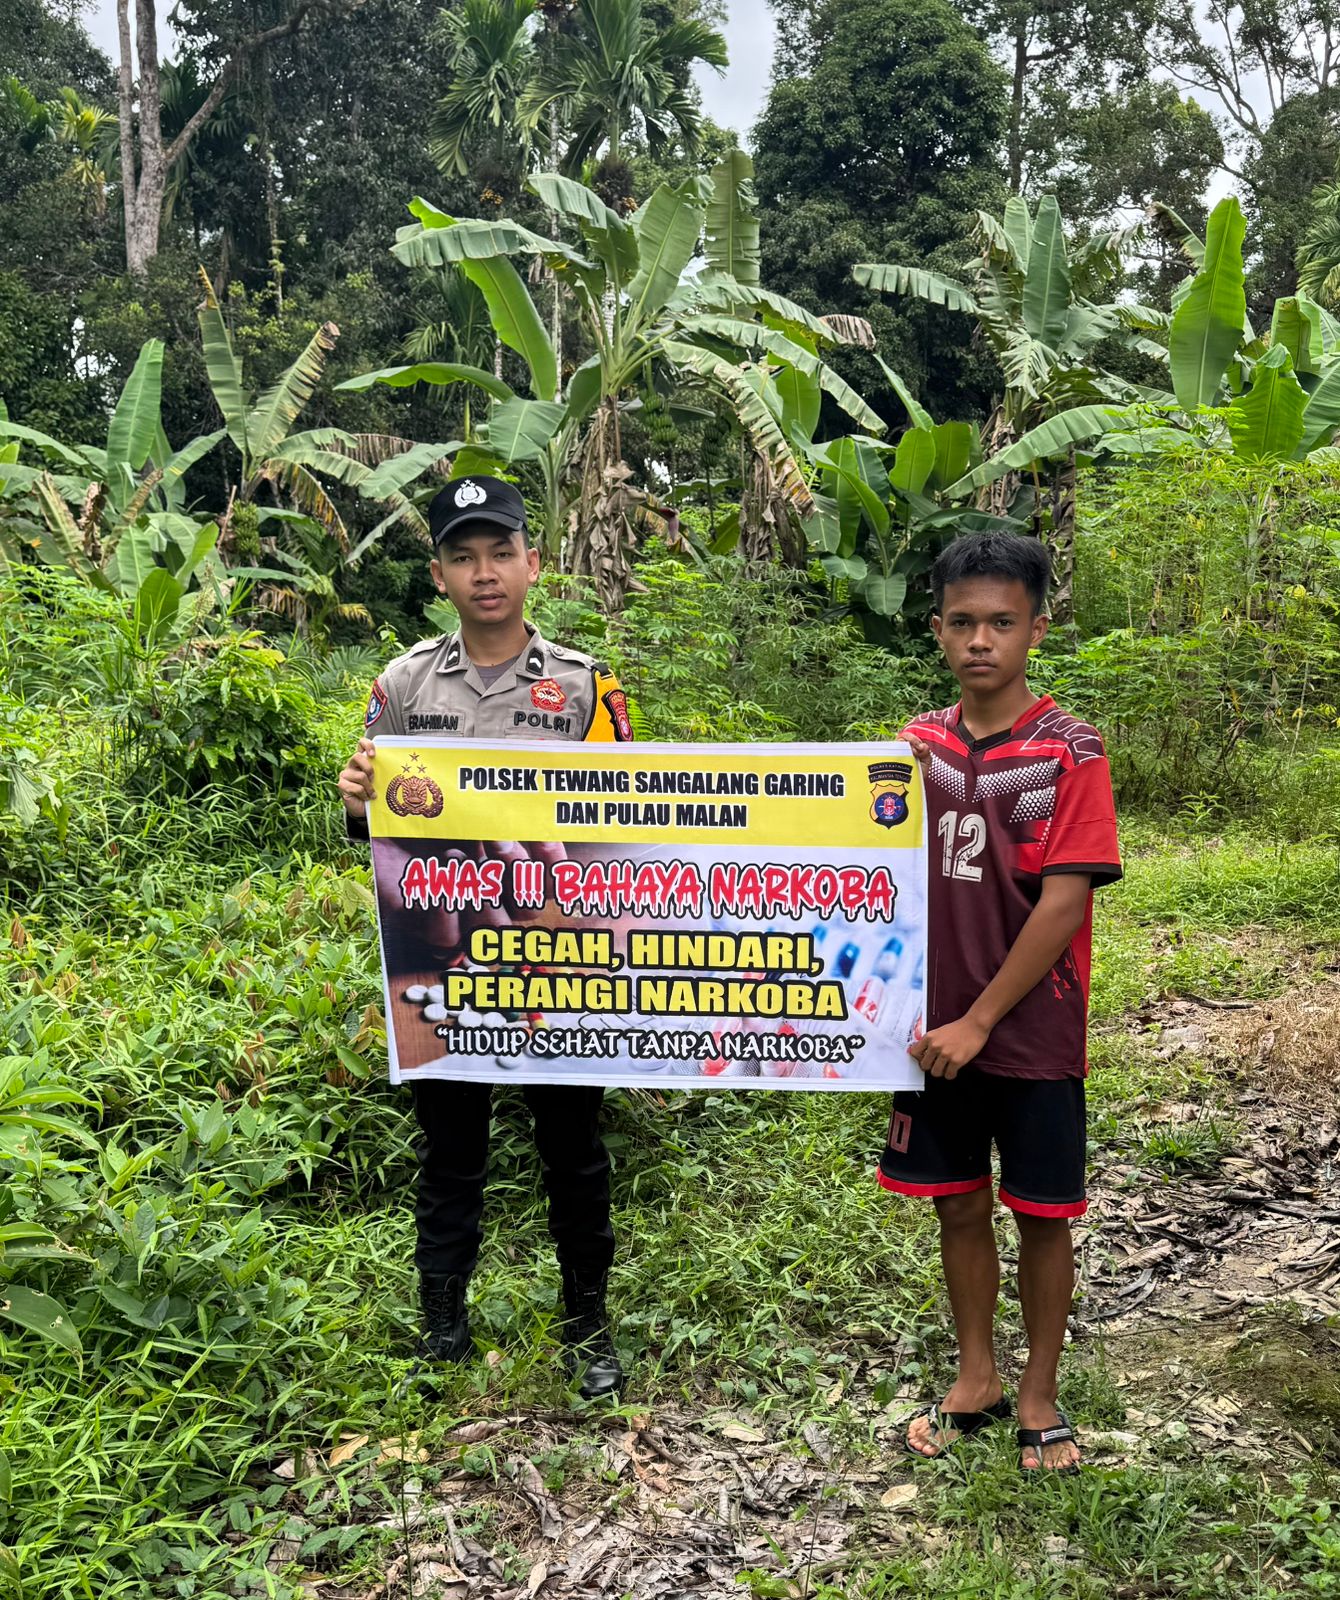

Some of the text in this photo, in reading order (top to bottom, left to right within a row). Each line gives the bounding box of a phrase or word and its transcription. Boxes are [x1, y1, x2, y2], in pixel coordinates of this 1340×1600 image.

[513, 710, 571, 733] POLRI
[458, 767, 845, 798] POLSEK TEWANG SANGALANG GARING
[556, 802, 748, 828] DAN PULAU MALAN
[938, 810, 986, 883] 12
[400, 855, 898, 922] AWAS !!! BAHAYA NARKOBA
[469, 928, 822, 974] CEGAH, HINDARI,
[446, 974, 845, 1018] PERANGI NARKOBA
[531, 1028, 621, 1058] SEHAT
[624, 1030, 719, 1060] TANPA
[887, 1108, 913, 1154] 0
